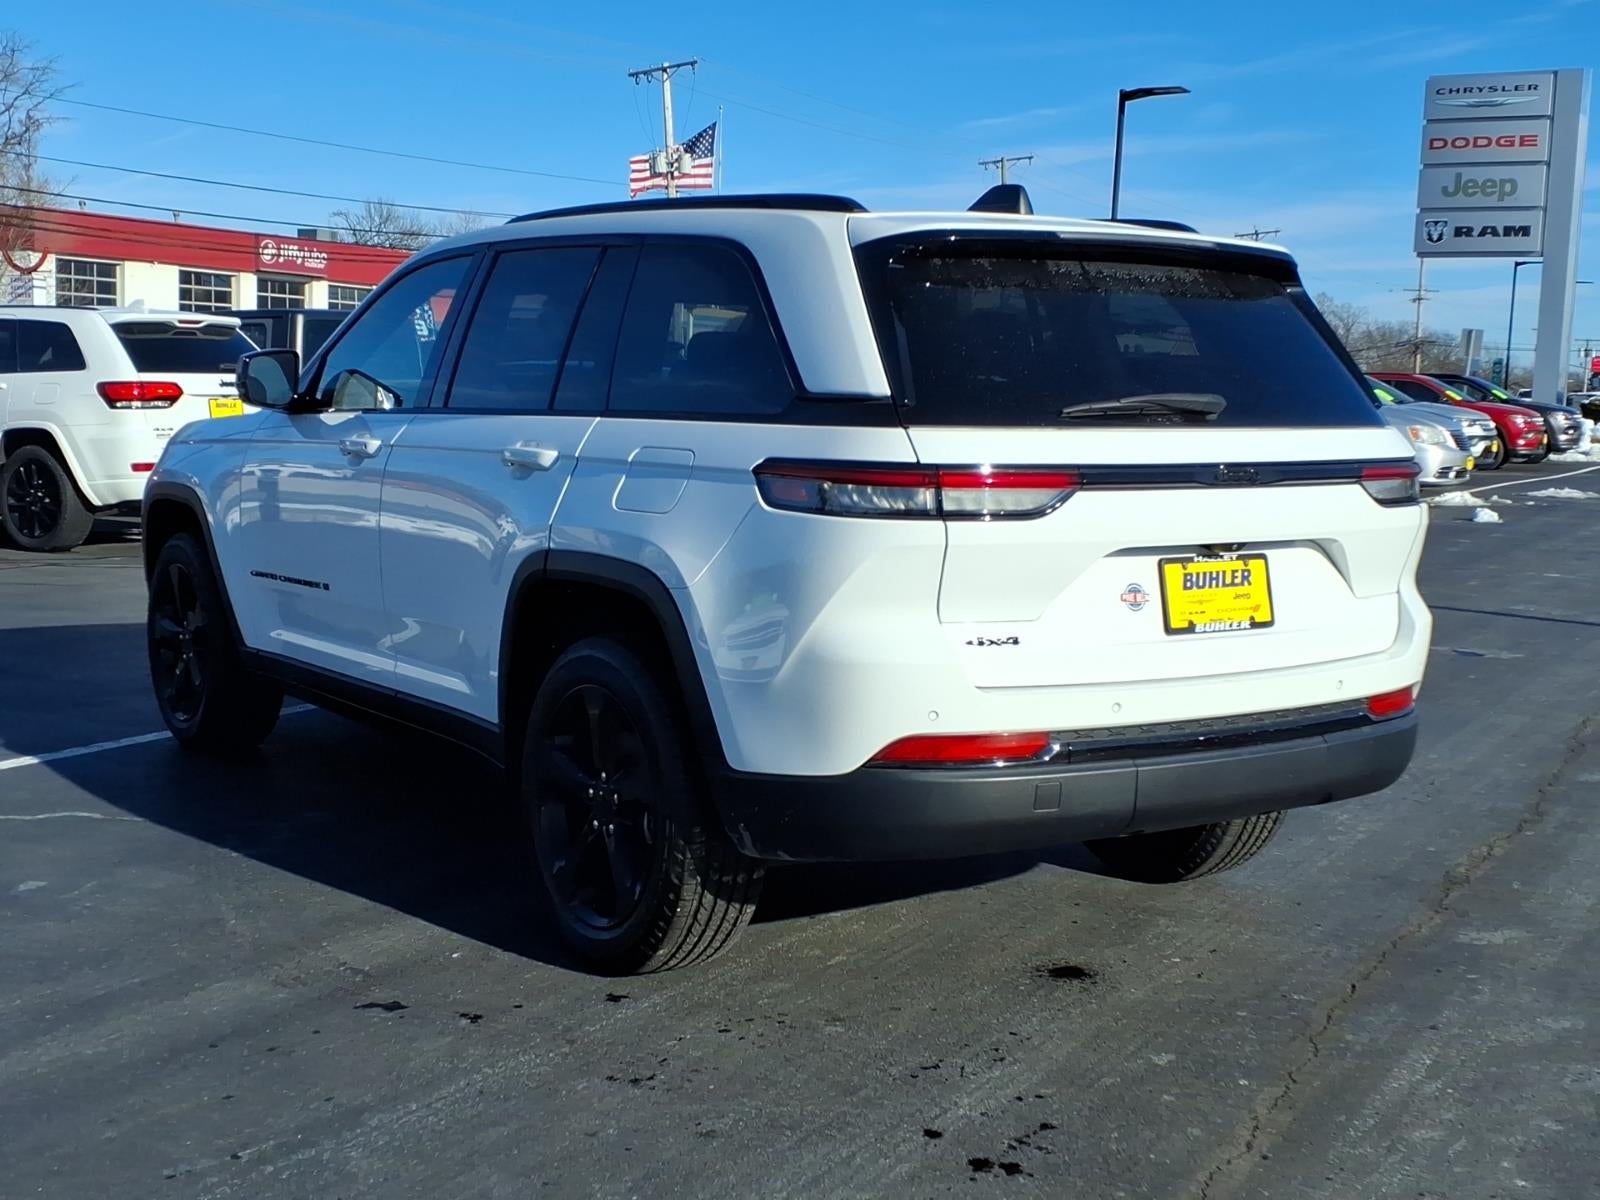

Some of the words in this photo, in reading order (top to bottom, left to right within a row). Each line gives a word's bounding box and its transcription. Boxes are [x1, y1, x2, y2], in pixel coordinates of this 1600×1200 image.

[1435, 83, 1540, 96] CHRYSLER
[1428, 135, 1539, 150] DODGE
[1441, 172, 1518, 202] Jeep
[1453, 225, 1531, 238] RAM
[1182, 568, 1252, 591] BUHLER
[1232, 591, 1251, 600] Jeep
[1194, 620, 1252, 633] BUHLER
